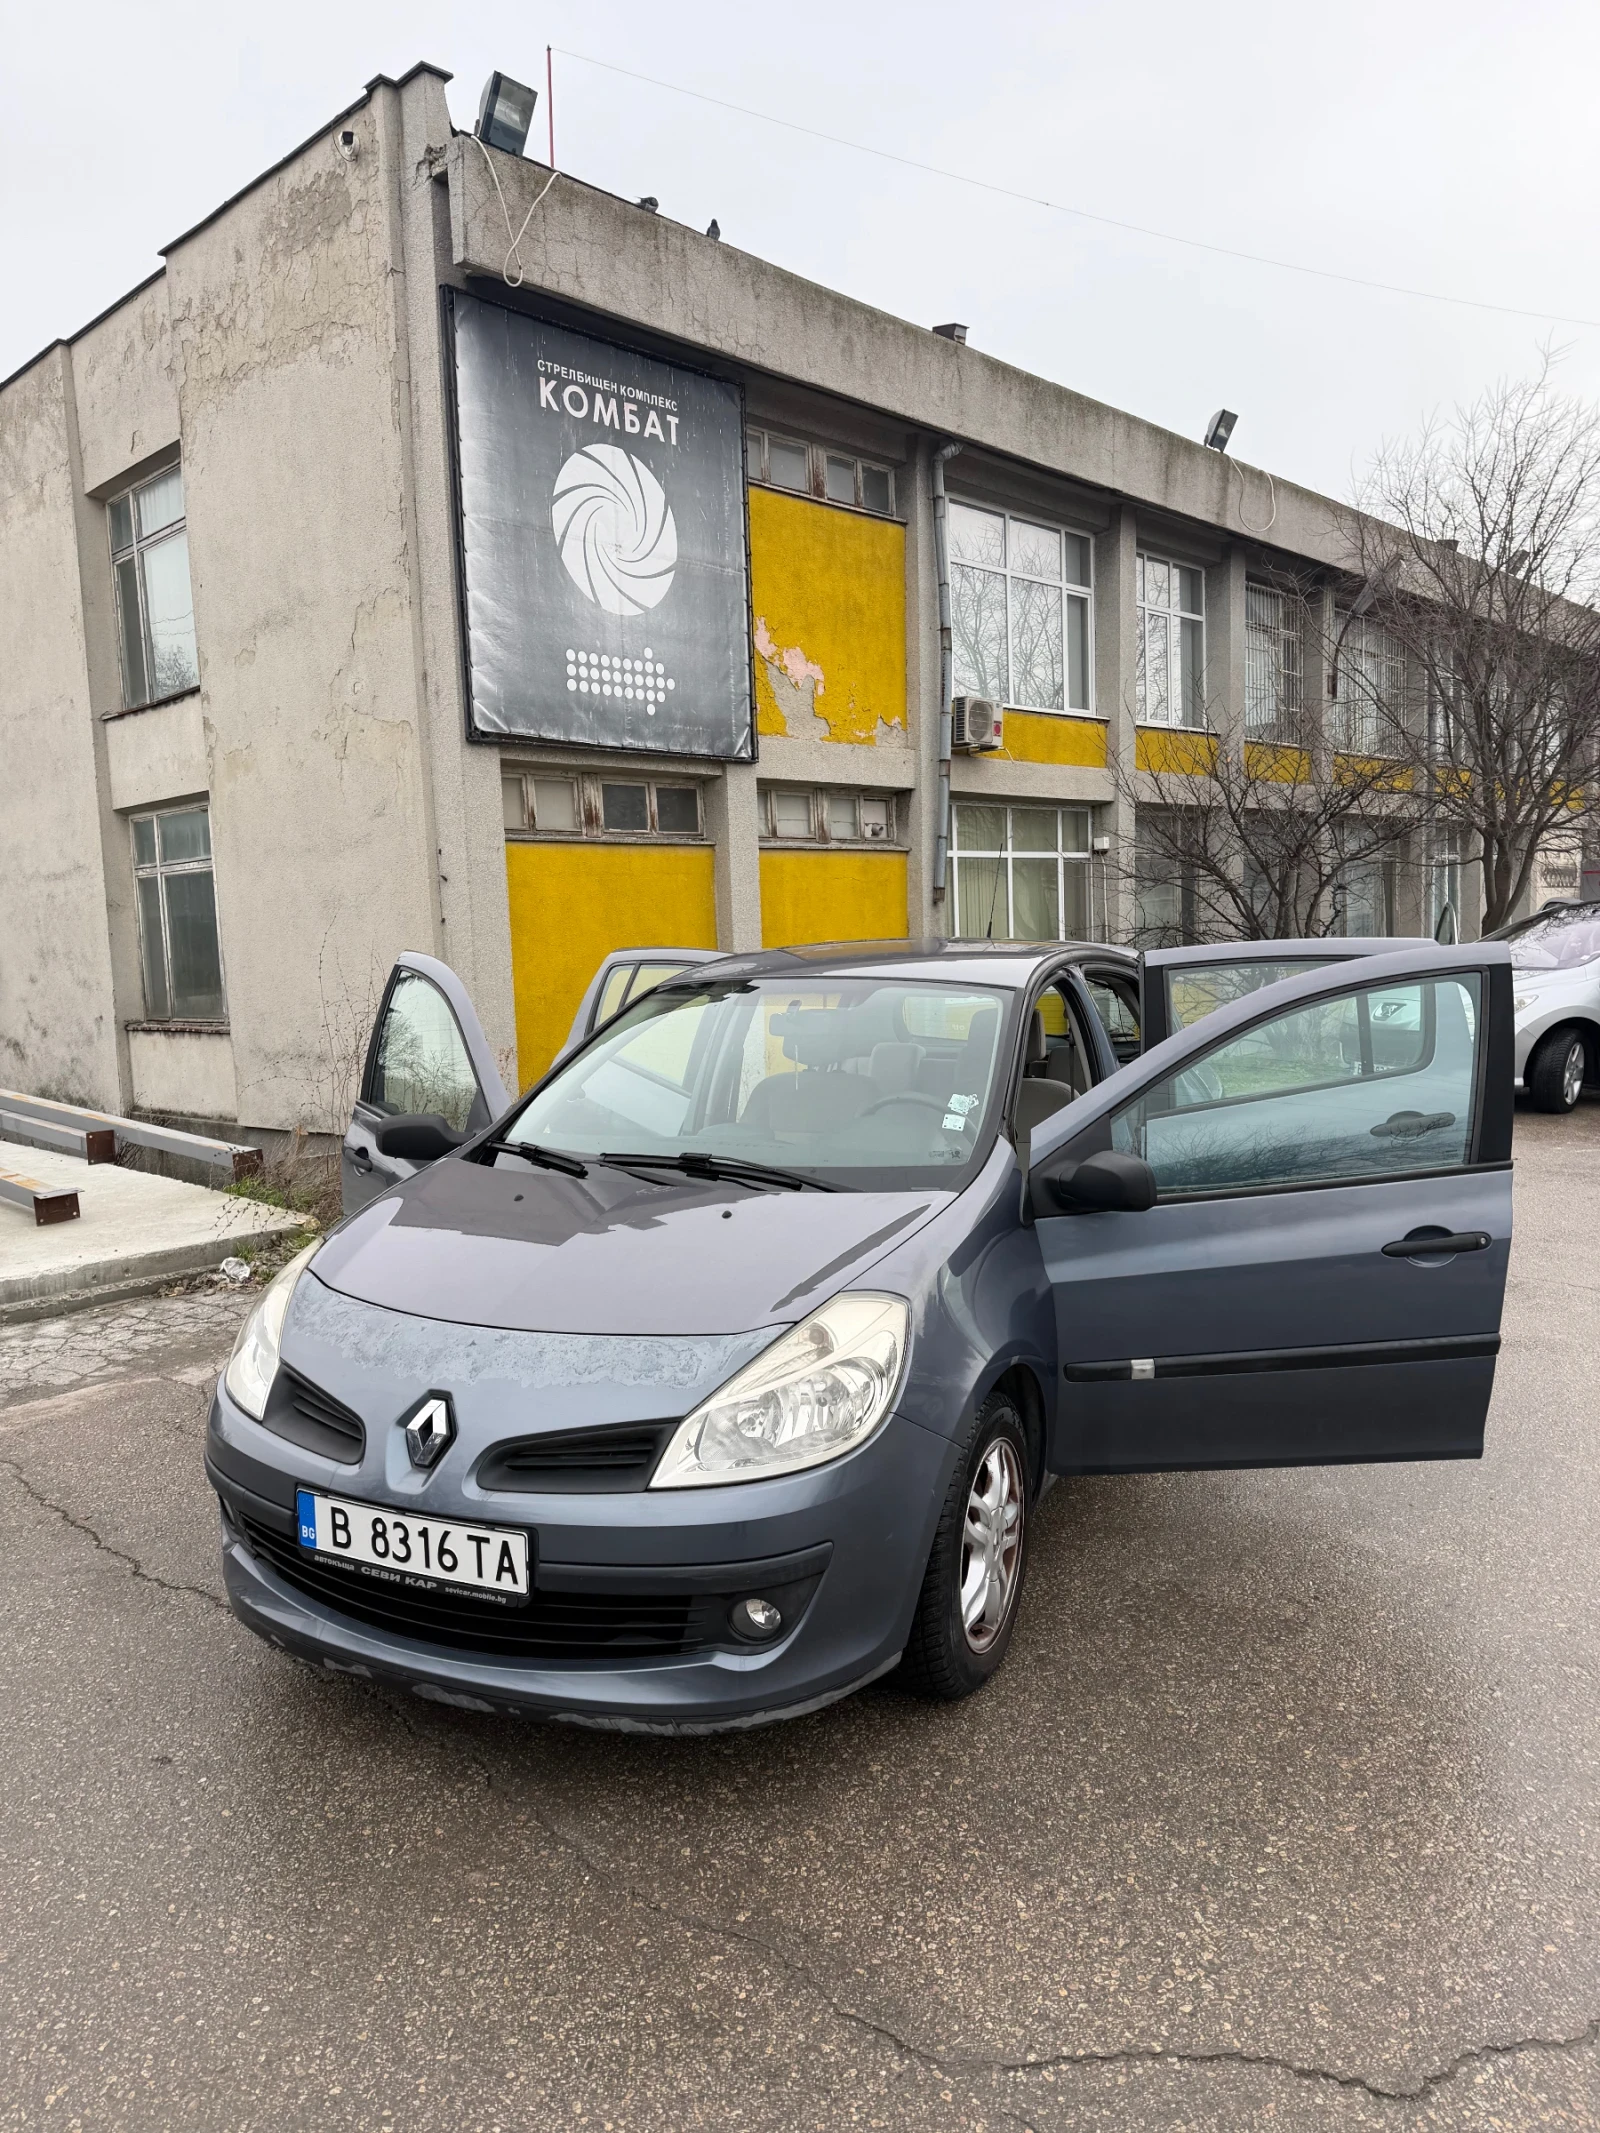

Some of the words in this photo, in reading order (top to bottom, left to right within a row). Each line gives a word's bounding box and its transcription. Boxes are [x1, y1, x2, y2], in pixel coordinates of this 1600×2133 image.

[537, 359, 618, 394] СТРЕЛБИЩЕН
[619, 385, 678, 412] КОМПЛЕКС
[539, 376, 680, 446] КОМБАТ
[301, 1524, 316, 1540] BG
[330, 1506, 351, 1549] B
[371, 1517, 459, 1573] 8316
[467, 1534, 519, 1586] TA
[314, 1554, 355, 1571] автокъща
[360, 1566, 401, 1583] СЕВИ
[404, 1576, 438, 1589] КАР
[444, 1586, 507, 1604] sevicar.mobile.bg
